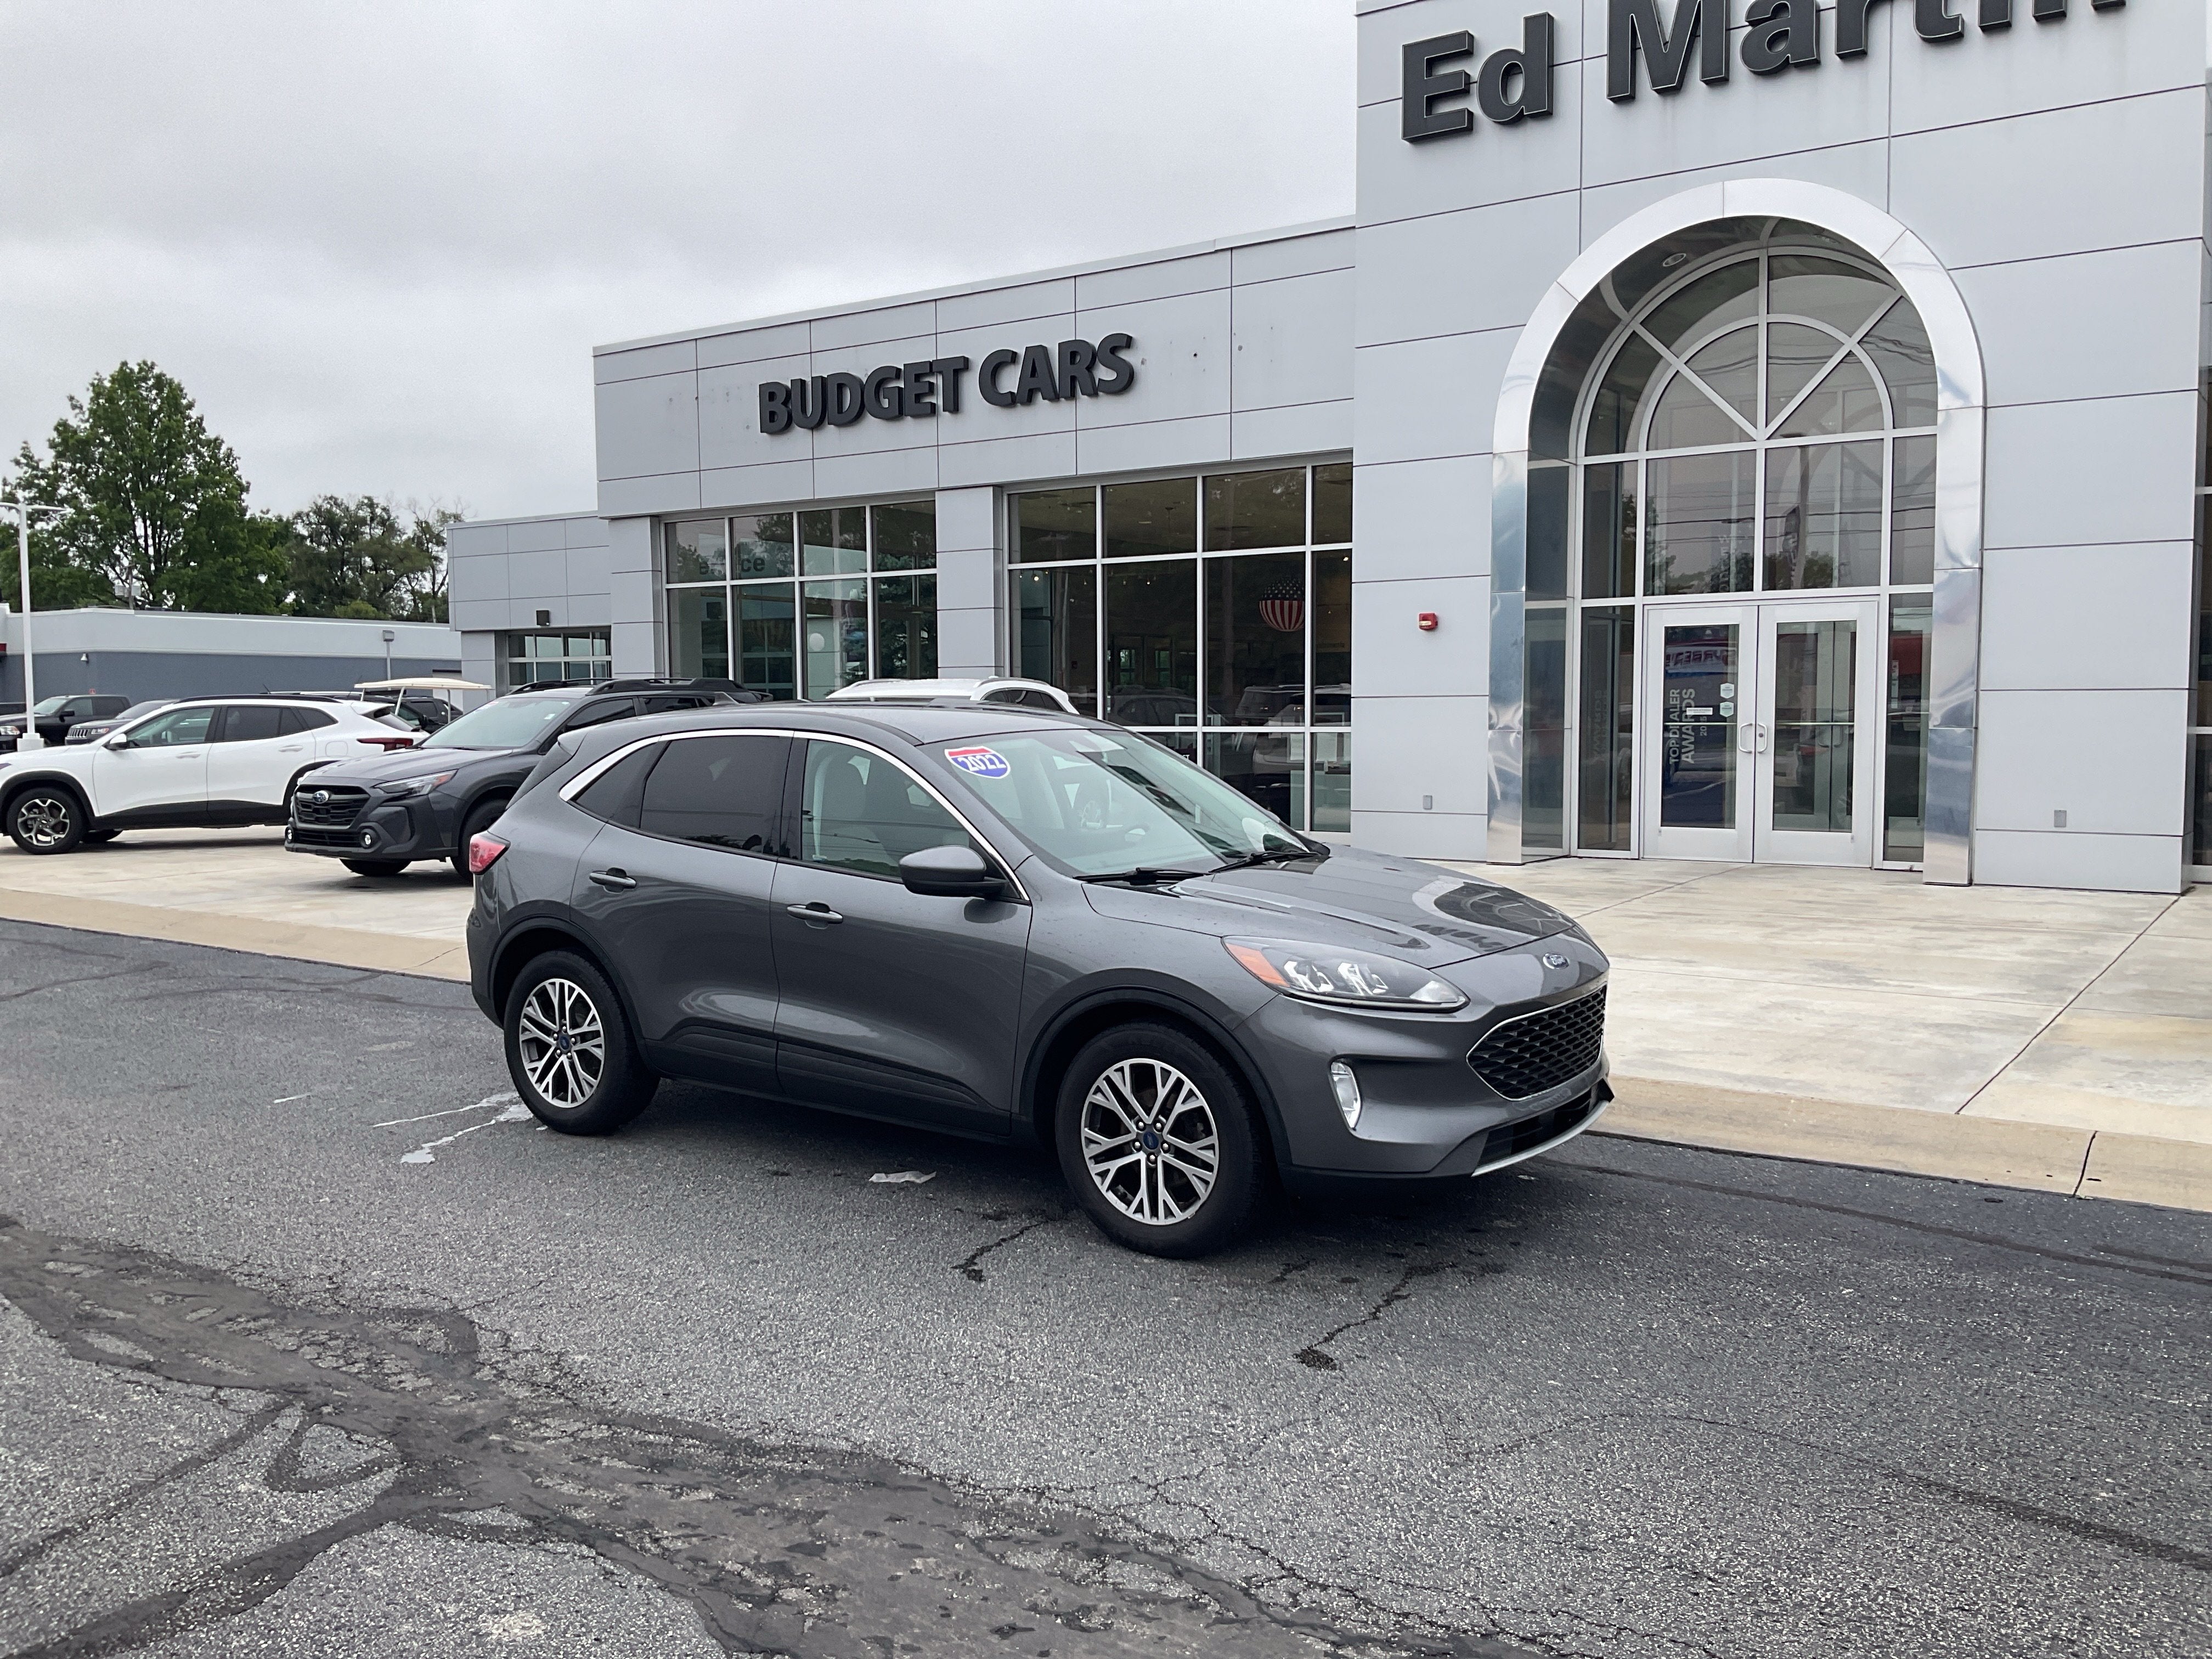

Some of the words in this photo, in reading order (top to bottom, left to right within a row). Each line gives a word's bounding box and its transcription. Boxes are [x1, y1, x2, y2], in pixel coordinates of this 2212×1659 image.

[1402, 11, 1554, 144] Ed
[1606, 0, 2128, 104] Mar
[759, 356, 969, 435] BUDGET
[978, 332, 1135, 407] CARS
[957, 754, 1007, 771] 2022
[1669, 740, 1679, 764] TOP
[1681, 688, 1695, 764] AWARDS
